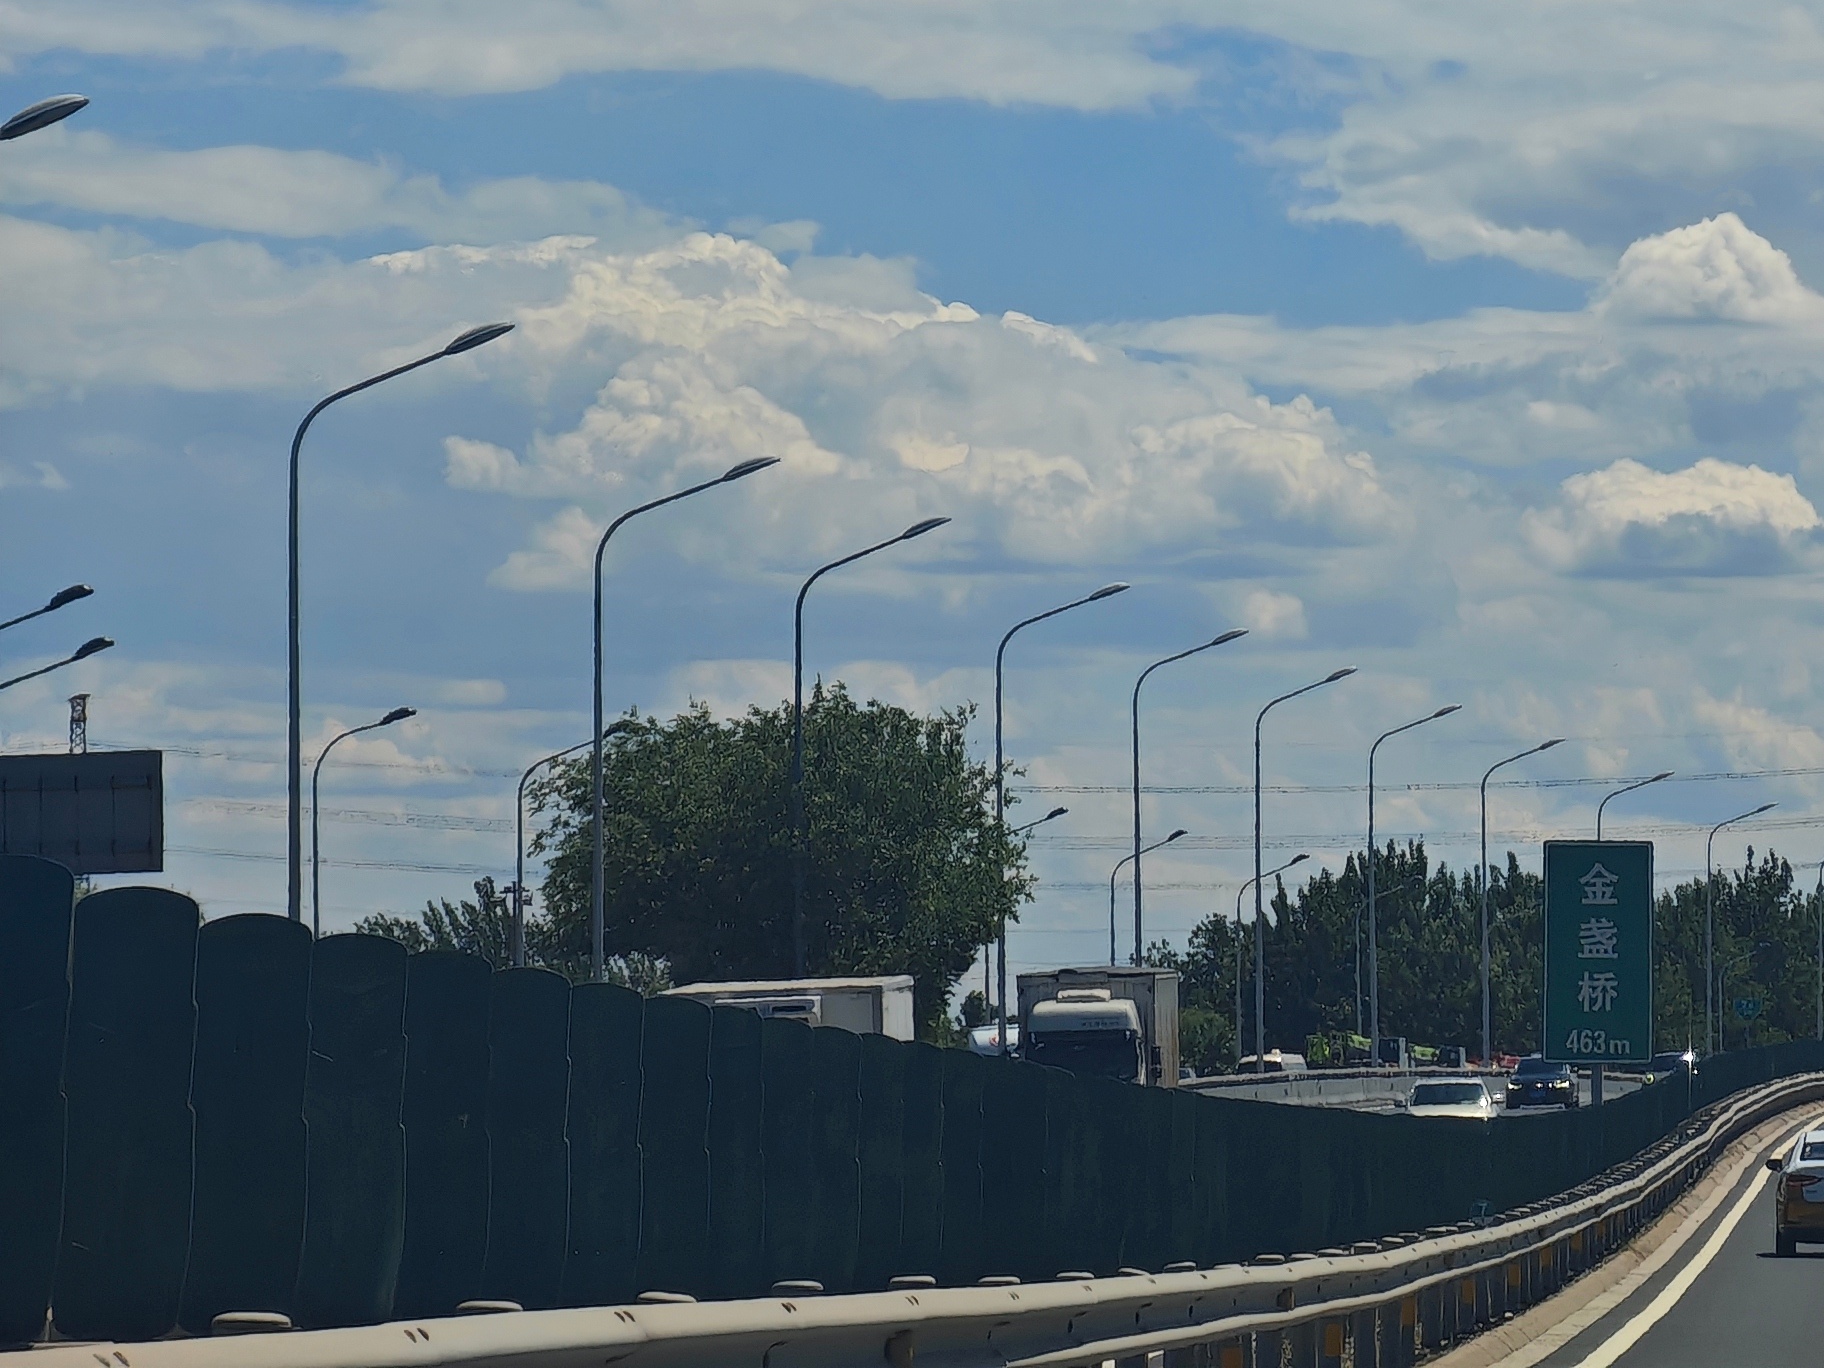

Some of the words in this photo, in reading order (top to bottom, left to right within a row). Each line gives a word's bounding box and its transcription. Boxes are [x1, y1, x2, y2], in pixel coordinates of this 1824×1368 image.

[1578, 862, 1619, 1013] 金盏桥
[1565, 1029, 1631, 1055] 463m
